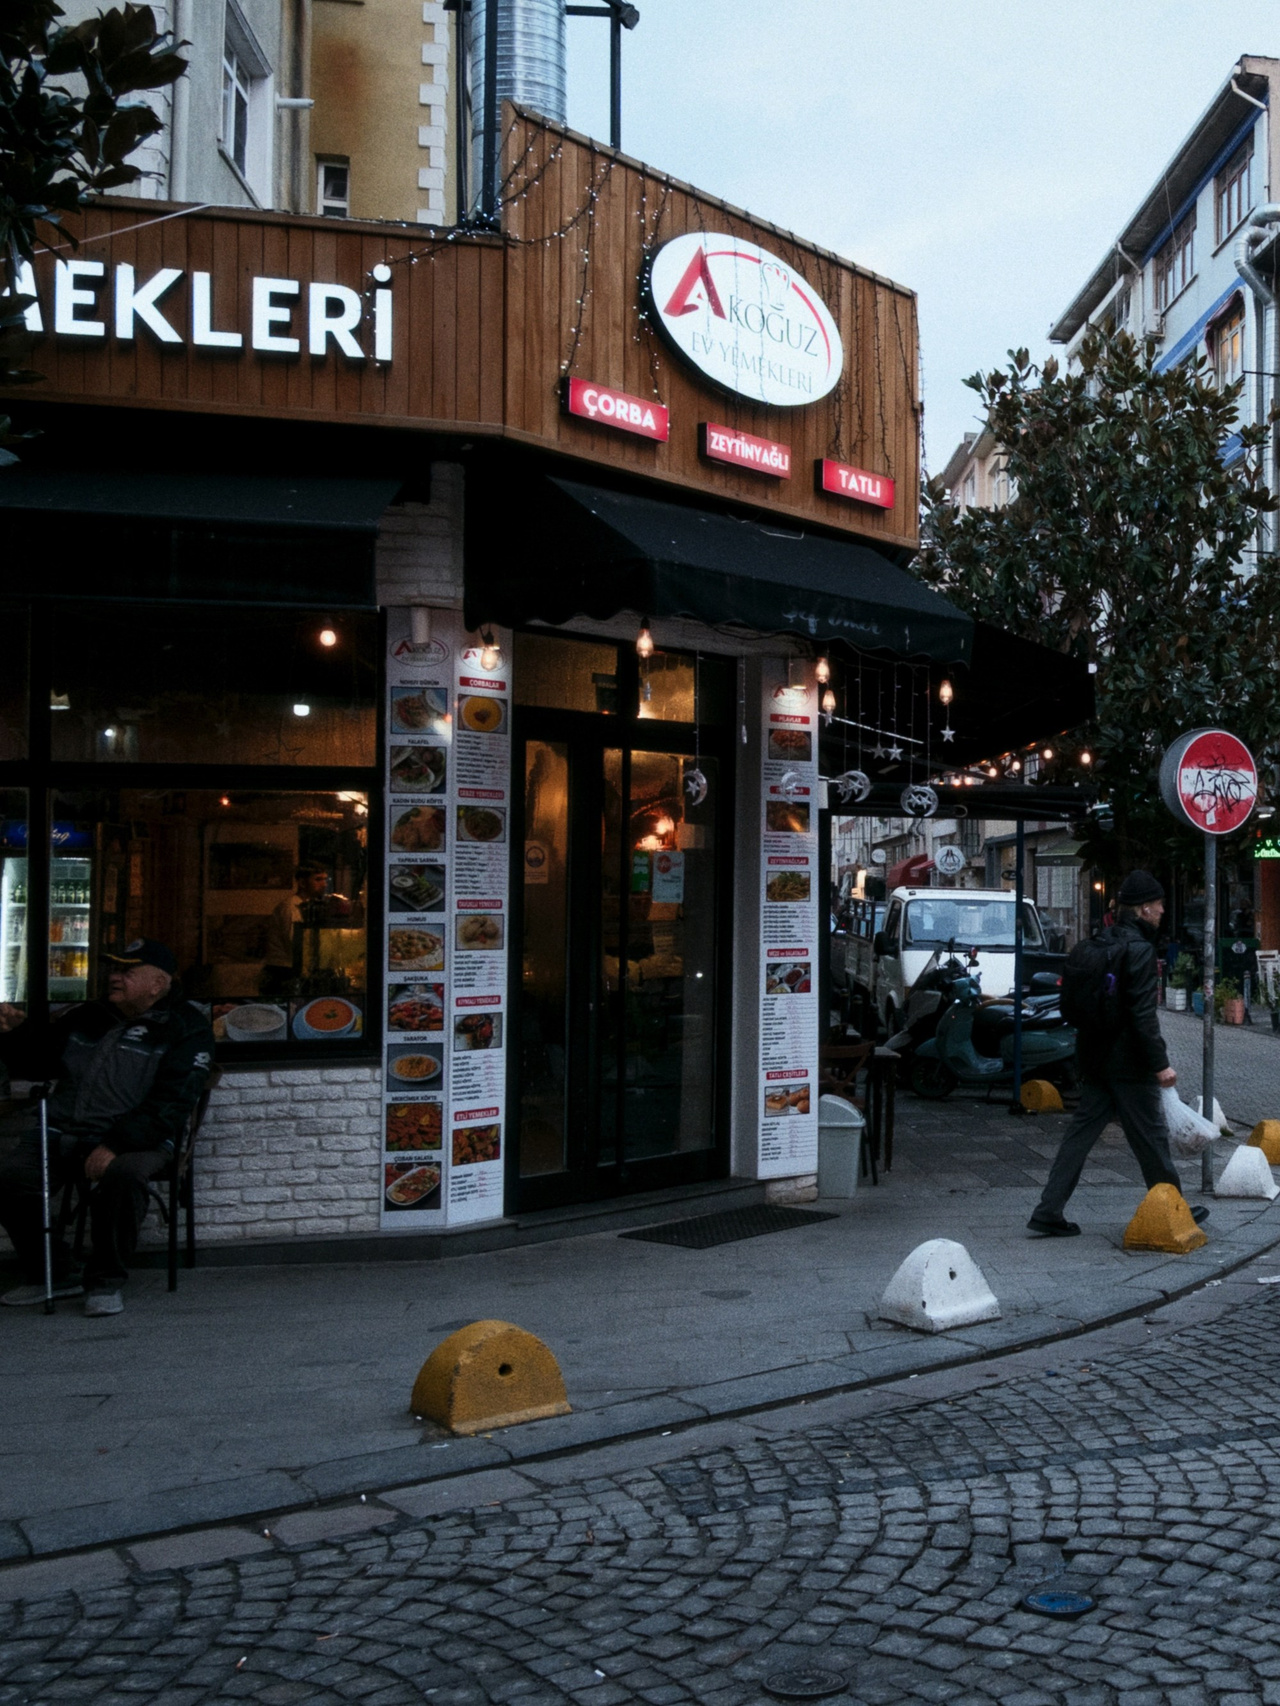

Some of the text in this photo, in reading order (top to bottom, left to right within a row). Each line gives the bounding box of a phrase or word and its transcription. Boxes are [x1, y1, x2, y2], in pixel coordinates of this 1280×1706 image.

[663, 245, 818, 357] AKOĞUZ
[692, 331, 812, 394] EV YEMEKLERİ
[582, 388, 656, 431] ÇORBA
[710, 430, 789, 471] ZEYTİNYAĞLI
[838, 468, 881, 499] TATLI
[469, 679, 500, 690] ÇORBALAR
